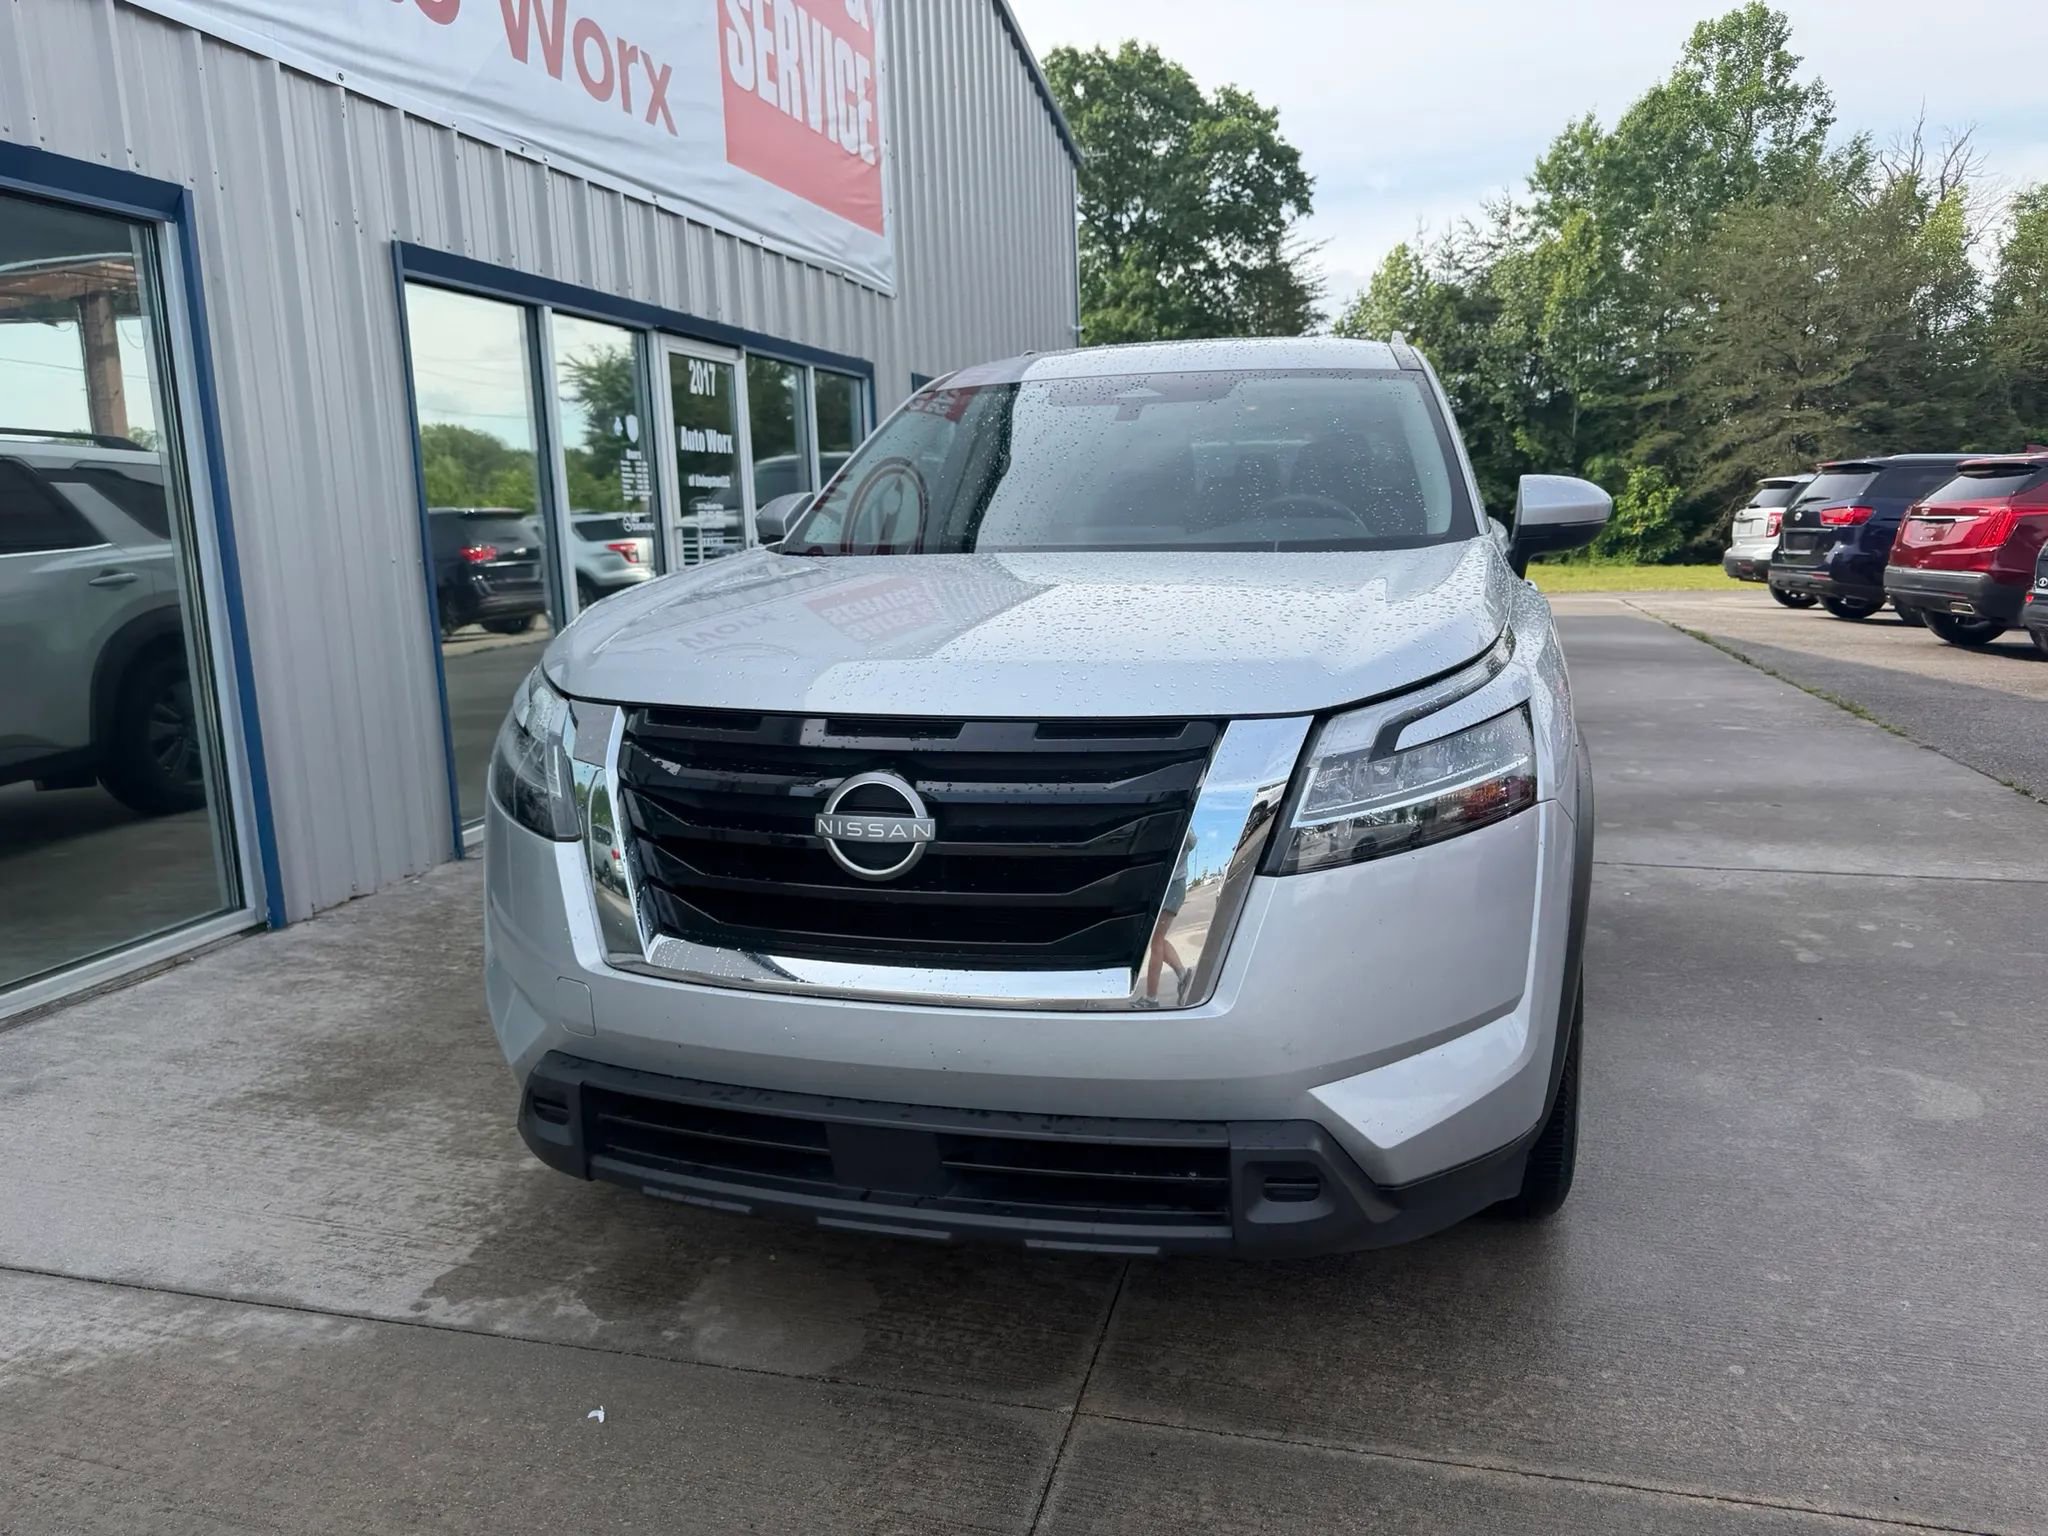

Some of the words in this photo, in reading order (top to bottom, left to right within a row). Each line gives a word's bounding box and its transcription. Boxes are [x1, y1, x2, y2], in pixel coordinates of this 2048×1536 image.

[499, 0, 679, 137] Worx
[724, 0, 876, 167] SERVICE
[688, 359, 716, 397] 2017
[680, 425, 705, 453] Auto
[705, 428, 733, 454] Worx
[818, 819, 931, 838] NISSAN
